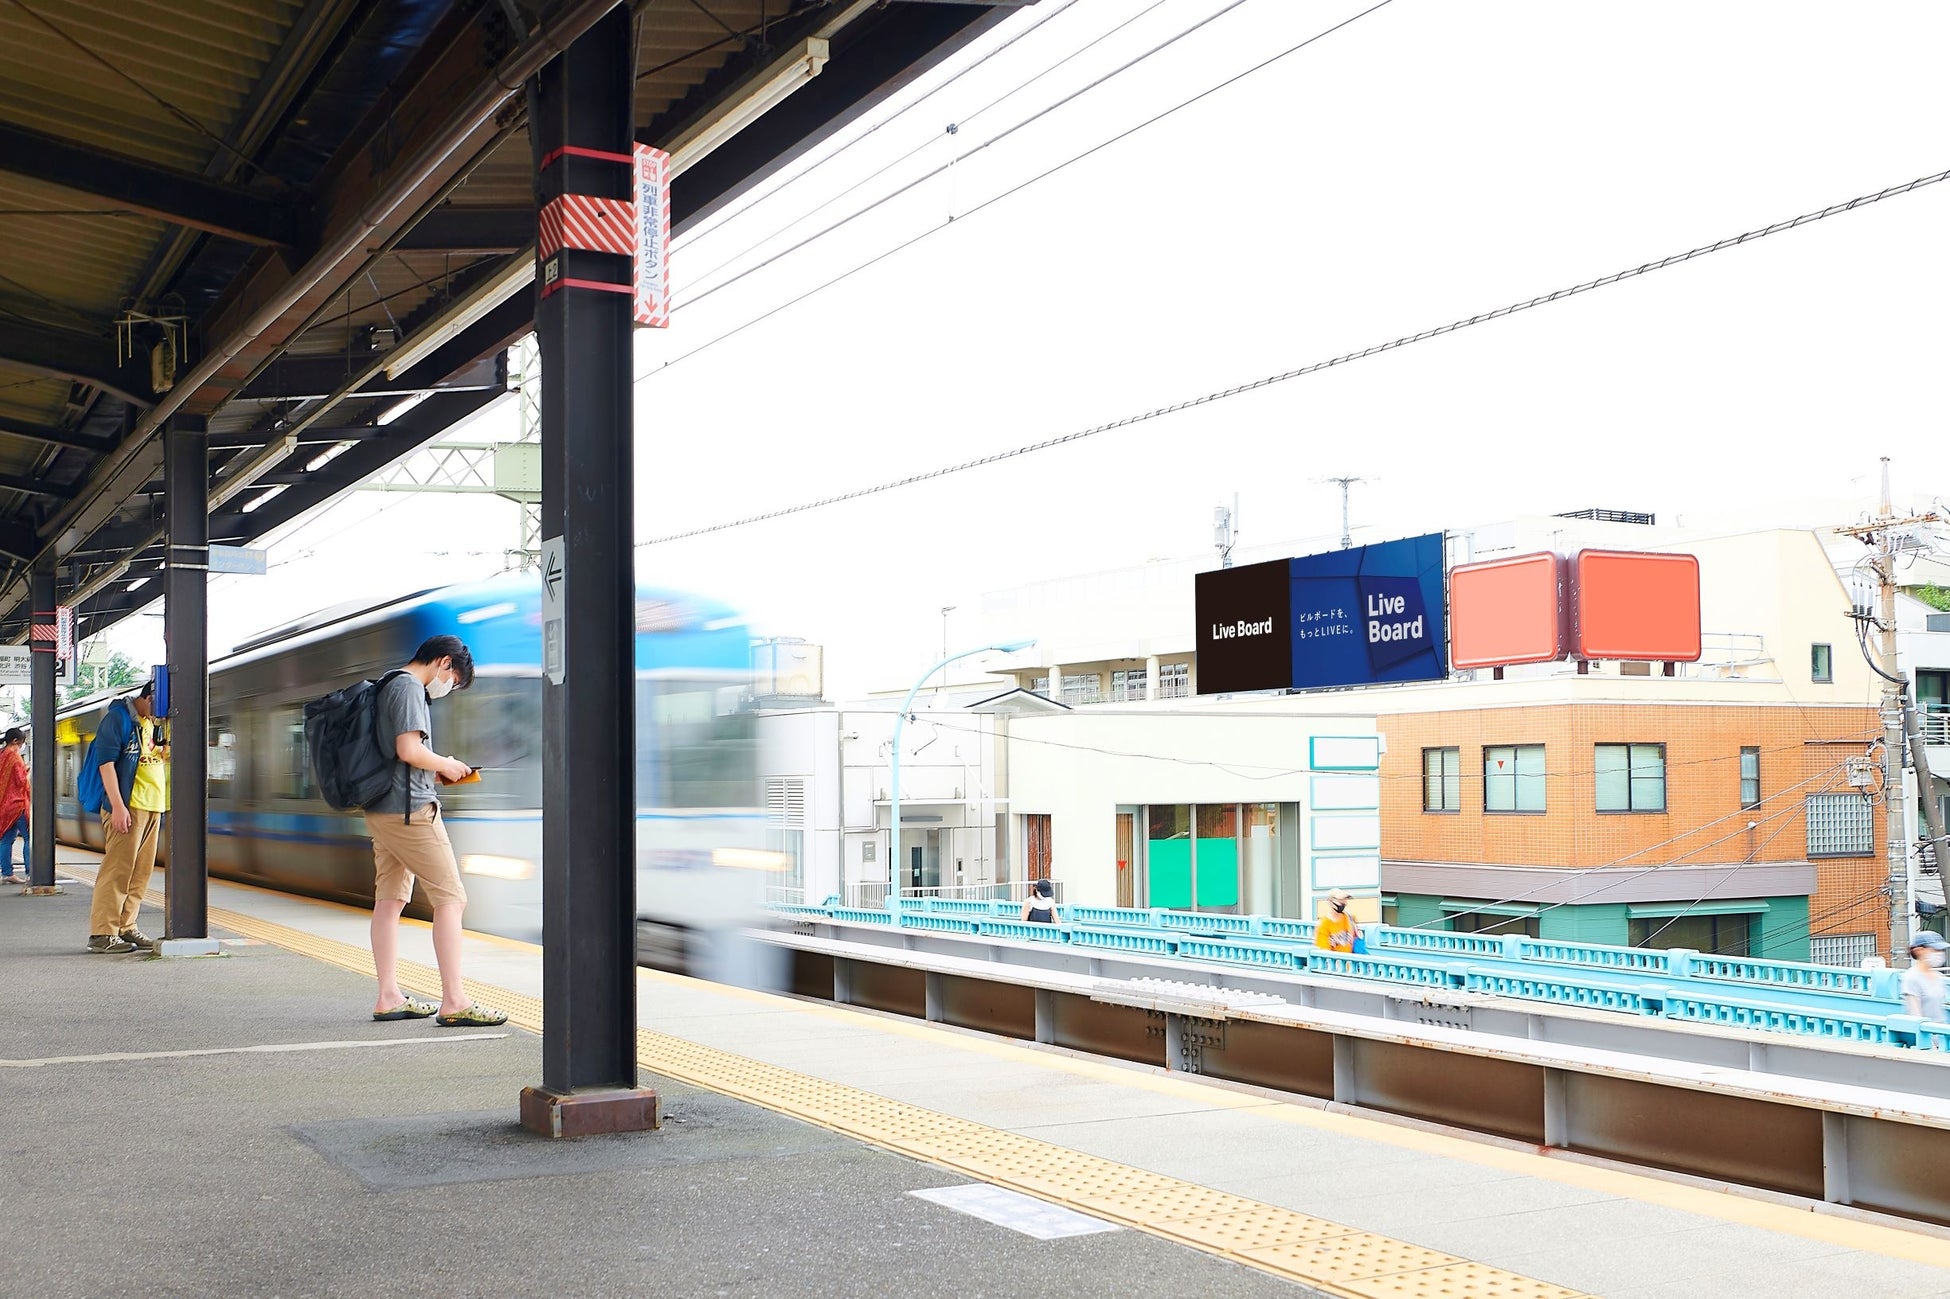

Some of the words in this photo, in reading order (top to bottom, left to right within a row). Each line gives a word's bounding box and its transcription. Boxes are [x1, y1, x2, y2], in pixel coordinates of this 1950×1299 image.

[642, 183, 659, 279] 列車非常停止ボタン
[1367, 593, 1405, 617] Live
[1212, 623, 1236, 640] Live
[1237, 616, 1272, 637] Board
[1368, 615, 1423, 643] Board
